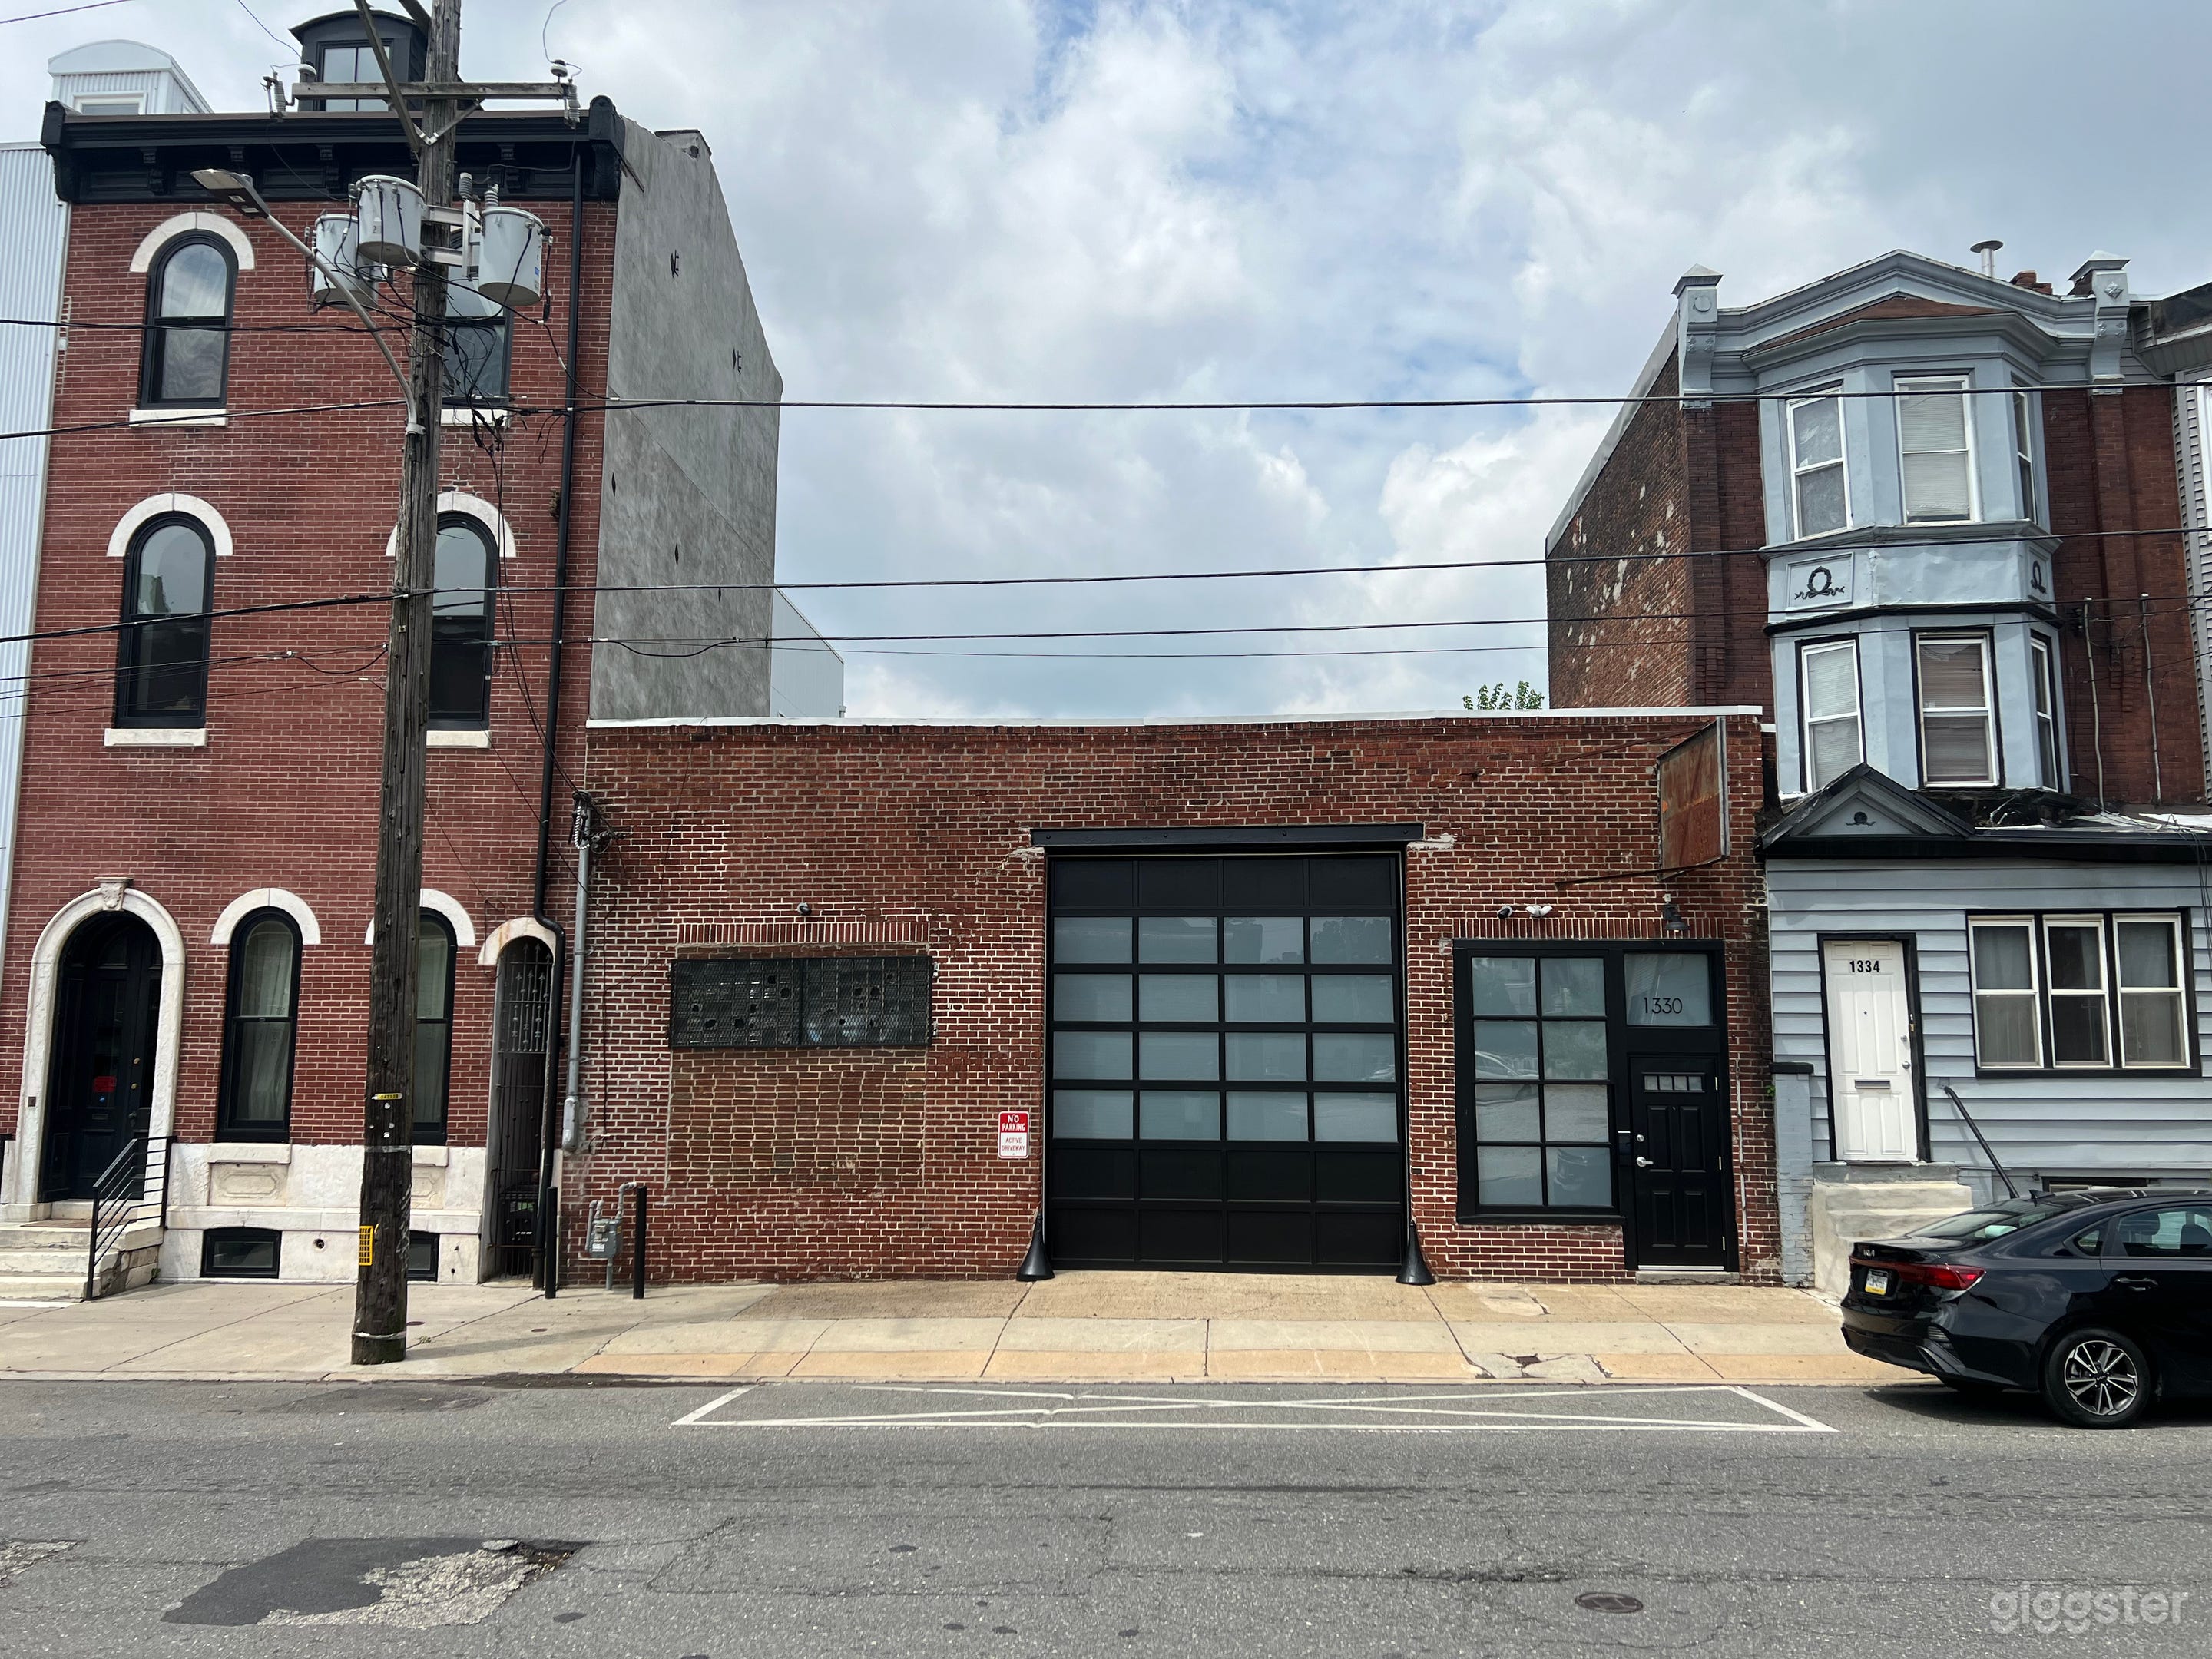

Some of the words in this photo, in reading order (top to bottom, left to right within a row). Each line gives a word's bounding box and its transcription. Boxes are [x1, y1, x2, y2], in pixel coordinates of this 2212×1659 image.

[1849, 960, 1880, 973] 1334
[1644, 997, 1683, 1014] 1330
[1008, 1114, 1019, 1123] NO
[1002, 1123, 1025, 1131] PARKING
